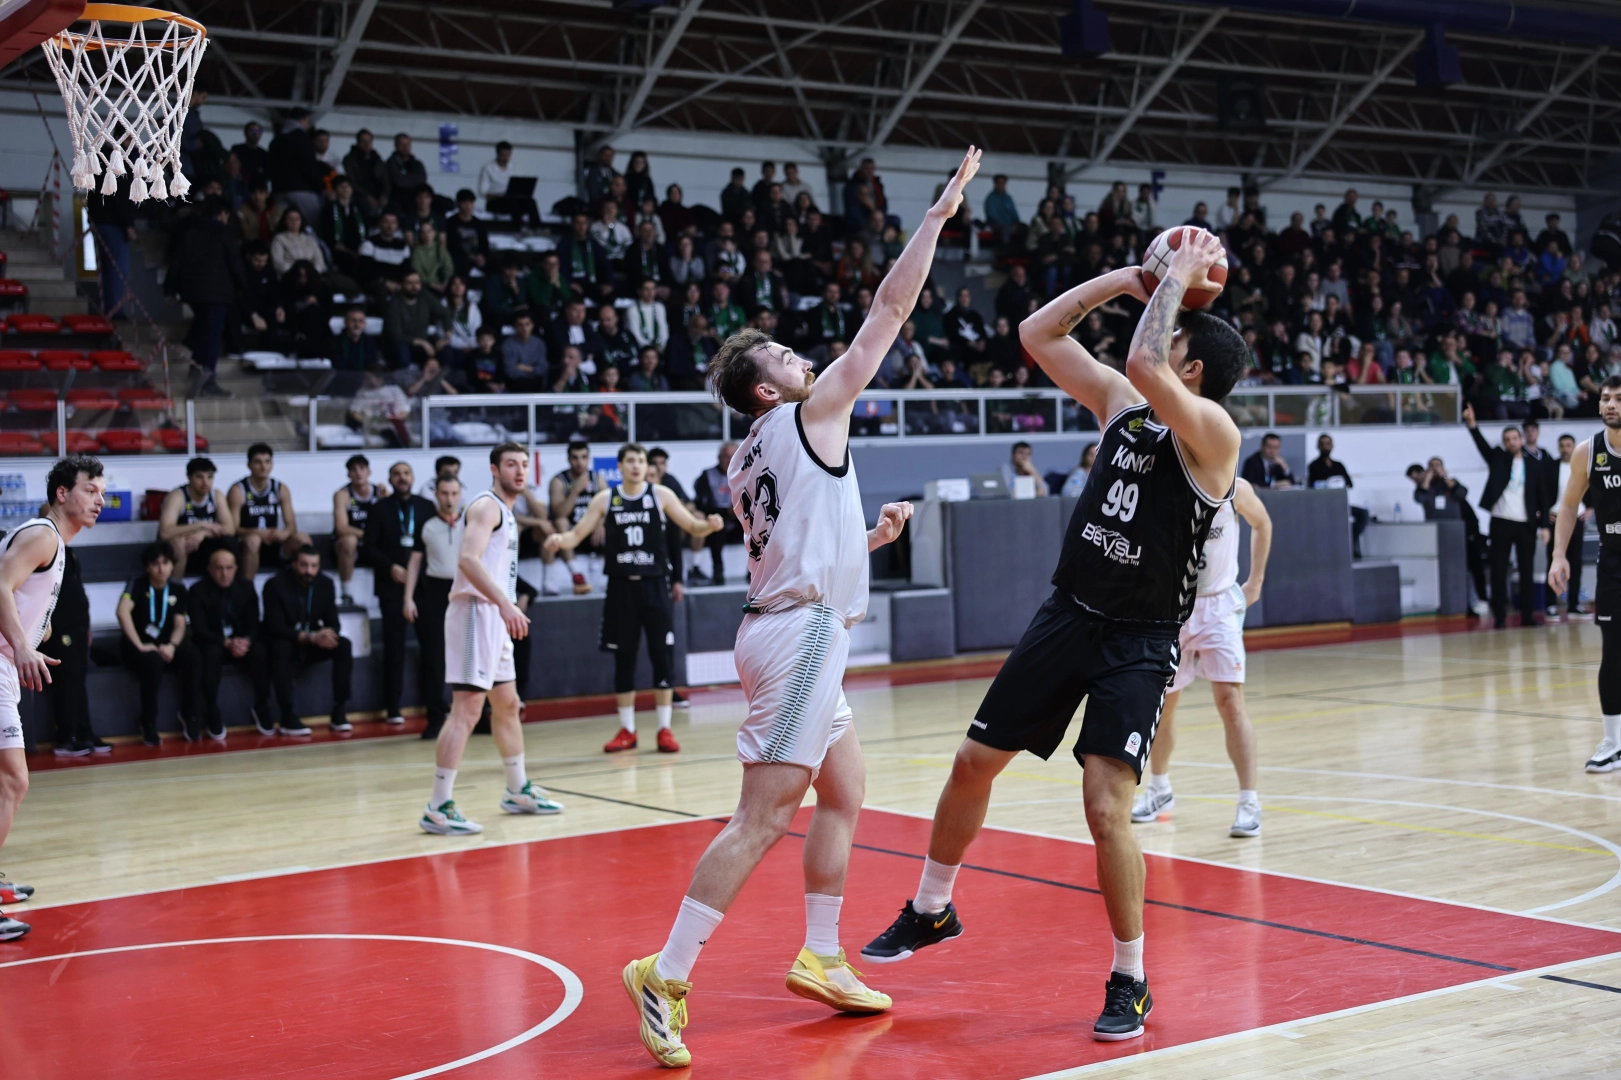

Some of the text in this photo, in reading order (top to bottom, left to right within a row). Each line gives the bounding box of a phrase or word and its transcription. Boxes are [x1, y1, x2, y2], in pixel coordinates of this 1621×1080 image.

[1101, 479, 1139, 522] 99
[614, 511, 651, 526] KONYA
[624, 525, 645, 546] 10
